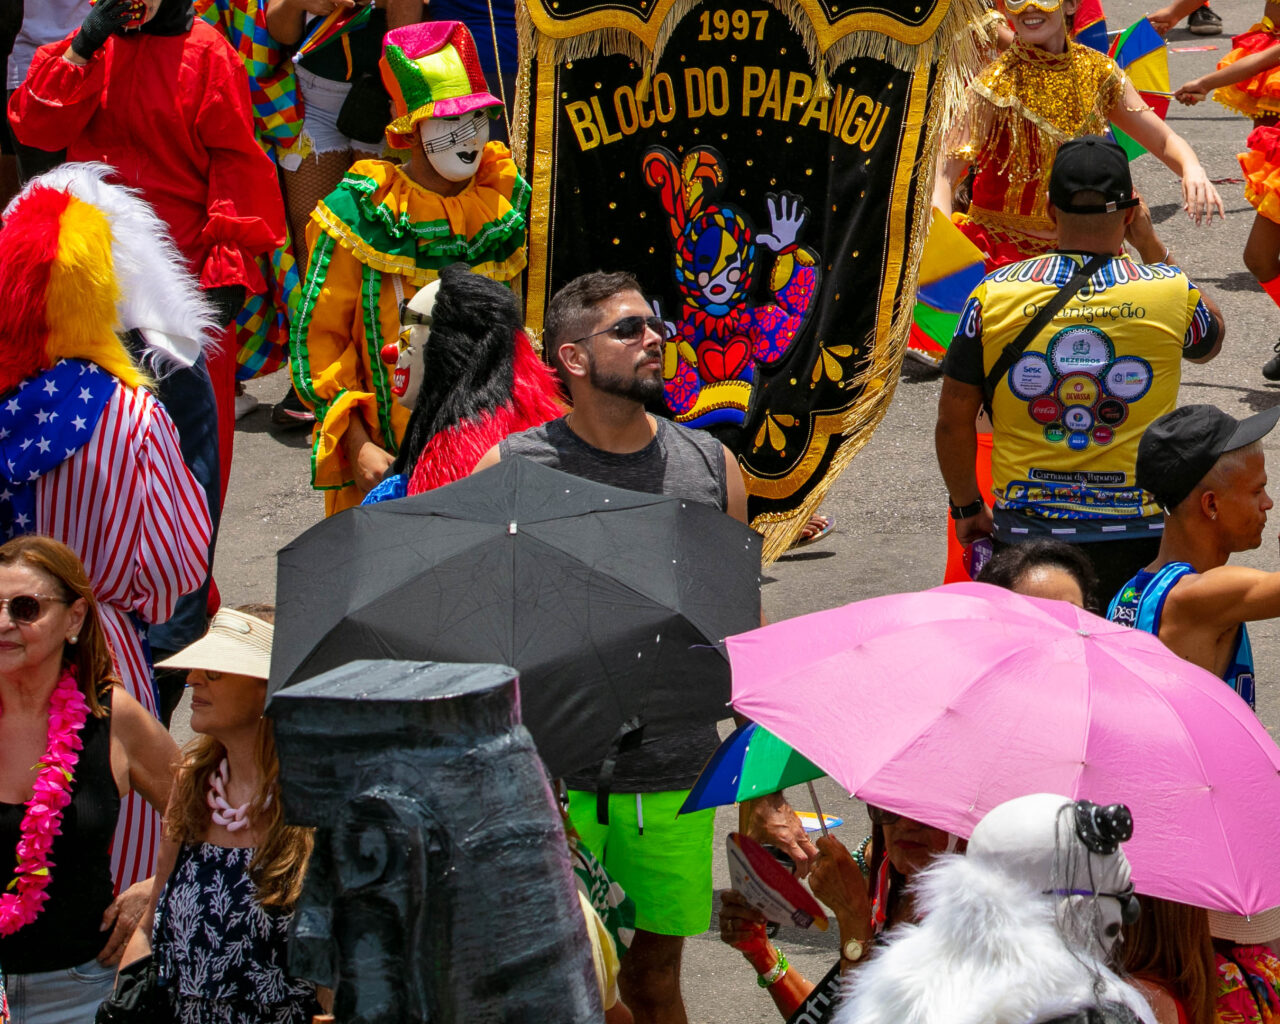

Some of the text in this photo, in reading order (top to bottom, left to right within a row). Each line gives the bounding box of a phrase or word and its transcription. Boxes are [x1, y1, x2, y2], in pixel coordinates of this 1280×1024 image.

[697, 9, 769, 41] 1997
[564, 66, 891, 153] BLOCO DO PAPANGU
[1023, 302, 1146, 323] Oanização
[1066, 392, 1091, 401] DEVASSA
